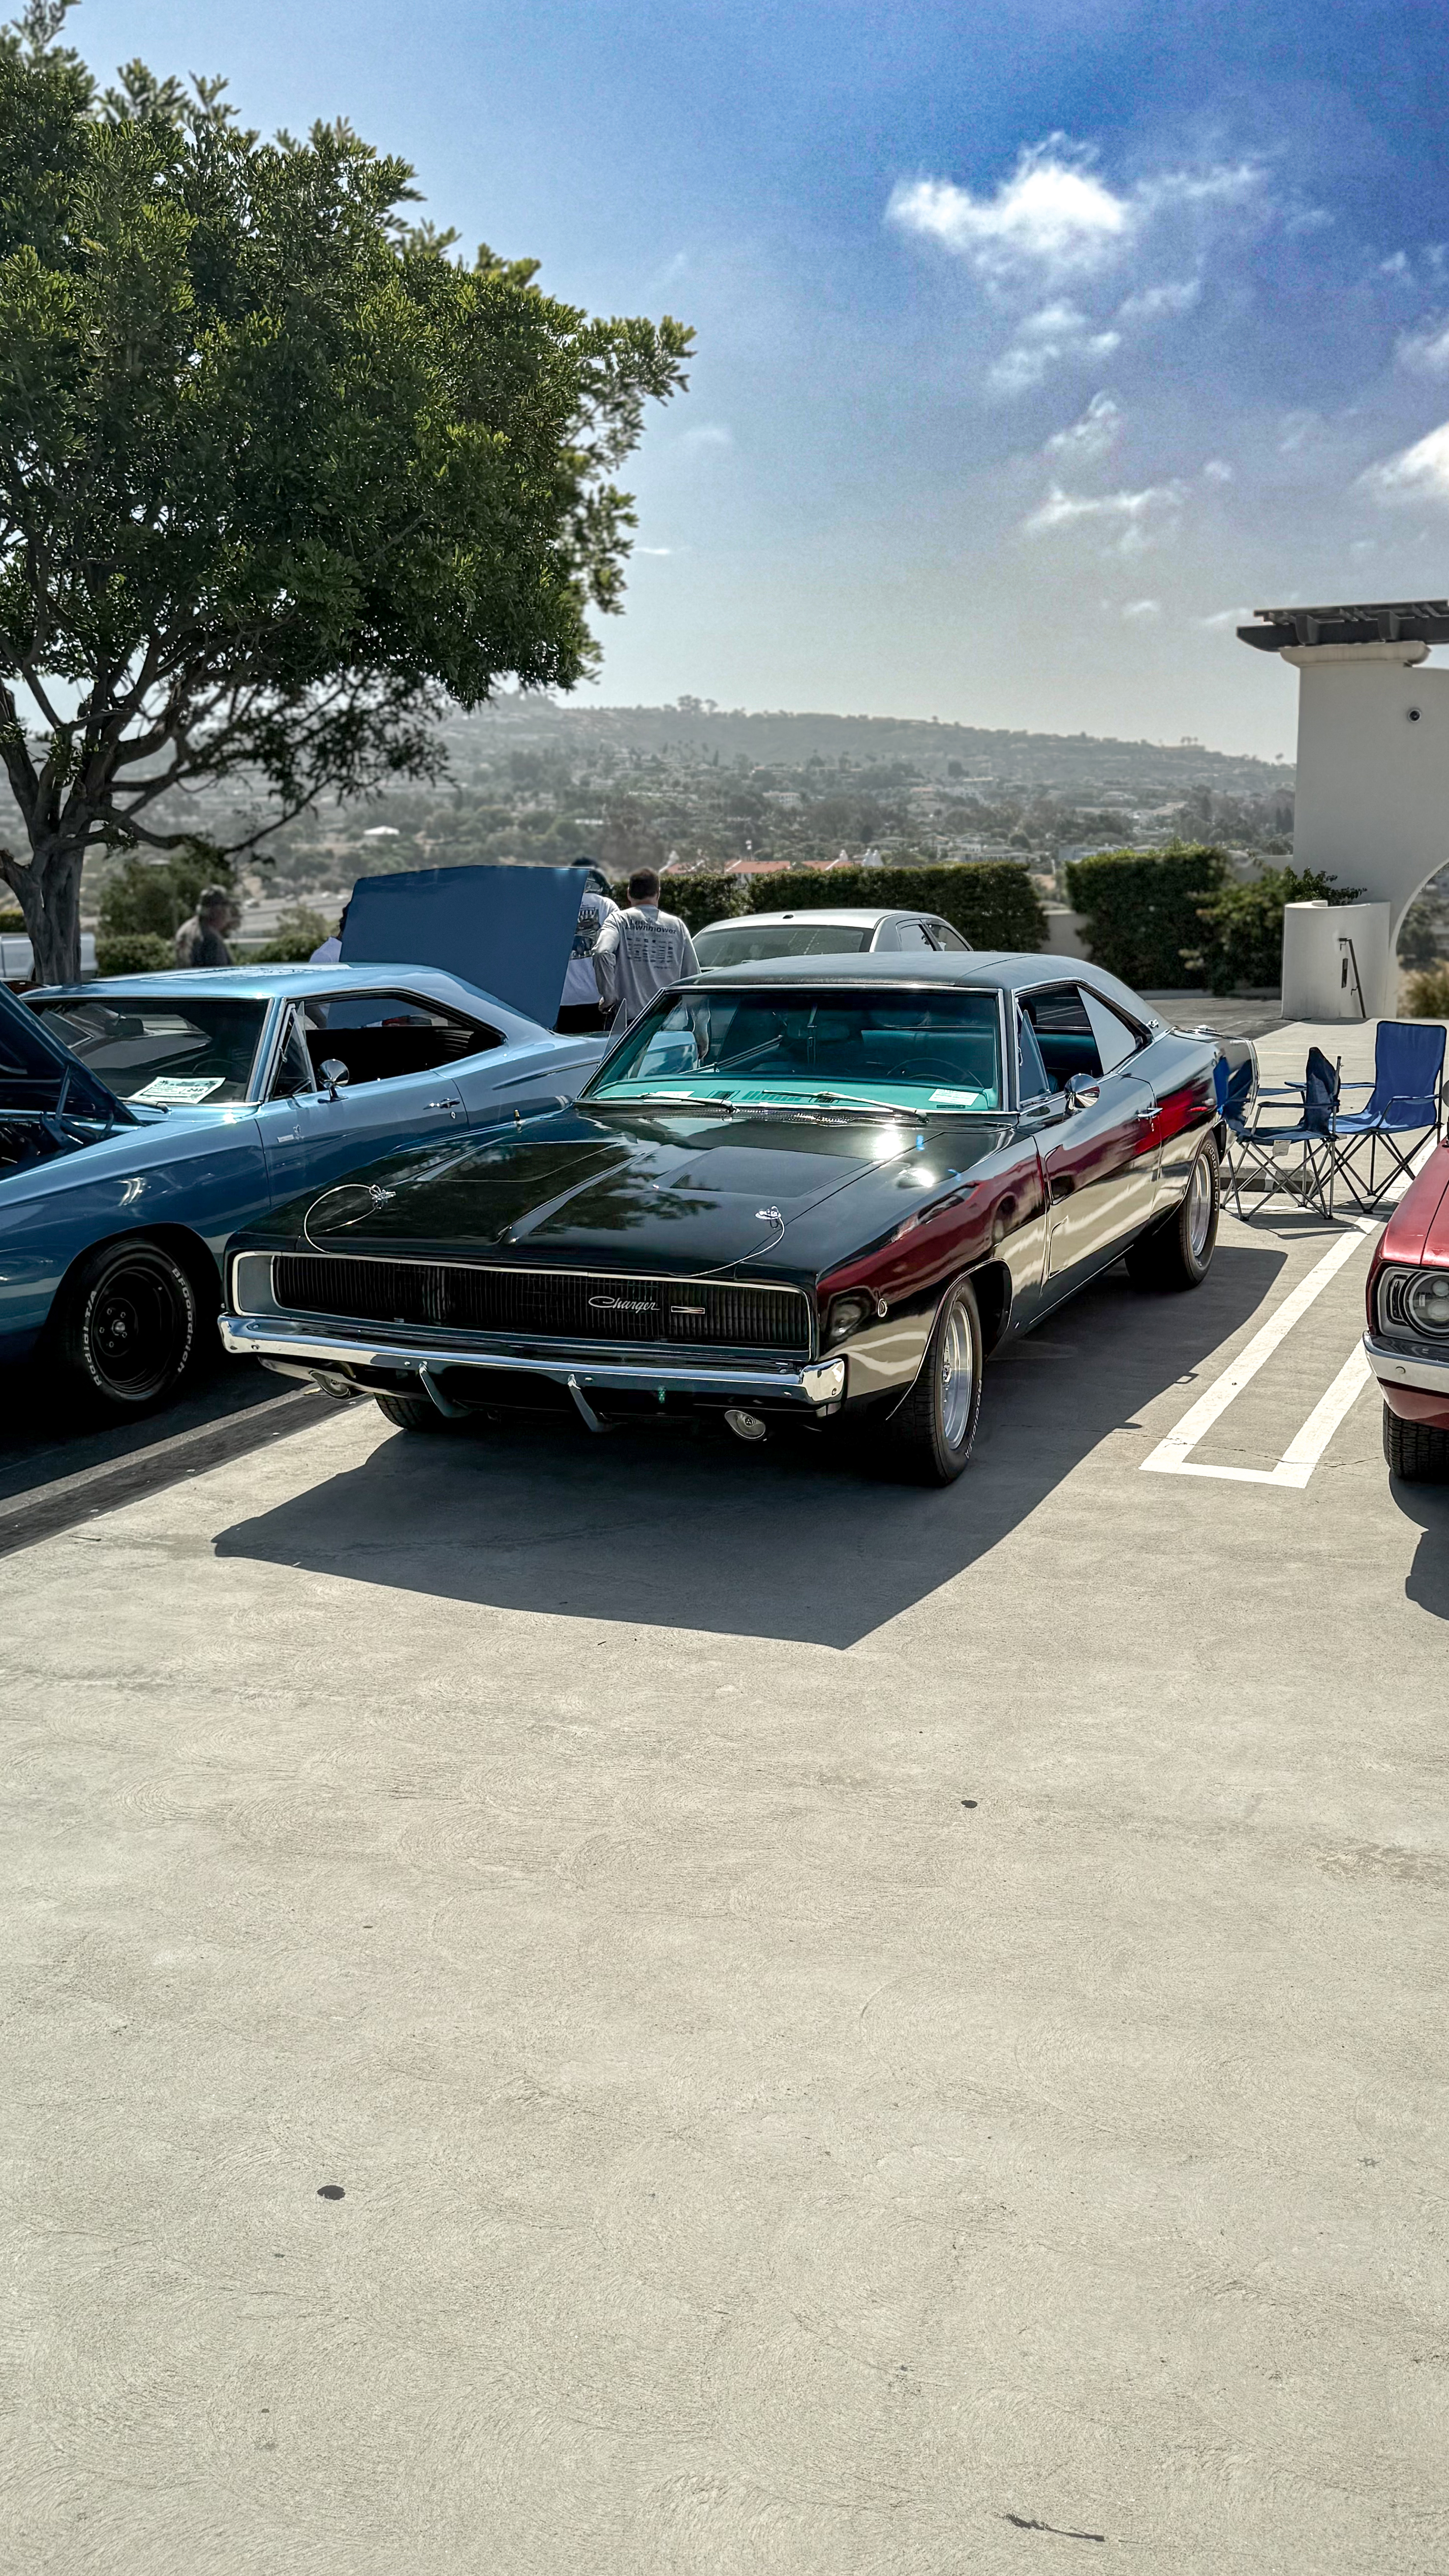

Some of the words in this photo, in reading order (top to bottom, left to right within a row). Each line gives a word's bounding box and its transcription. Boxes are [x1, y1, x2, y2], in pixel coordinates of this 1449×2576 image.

[85, 1291, 97, 1318] T/A
[172, 1268, 193, 1372] BFGoodrich
[588, 1296, 660, 1313] Charger
[83, 1326, 102, 1386] Radial
